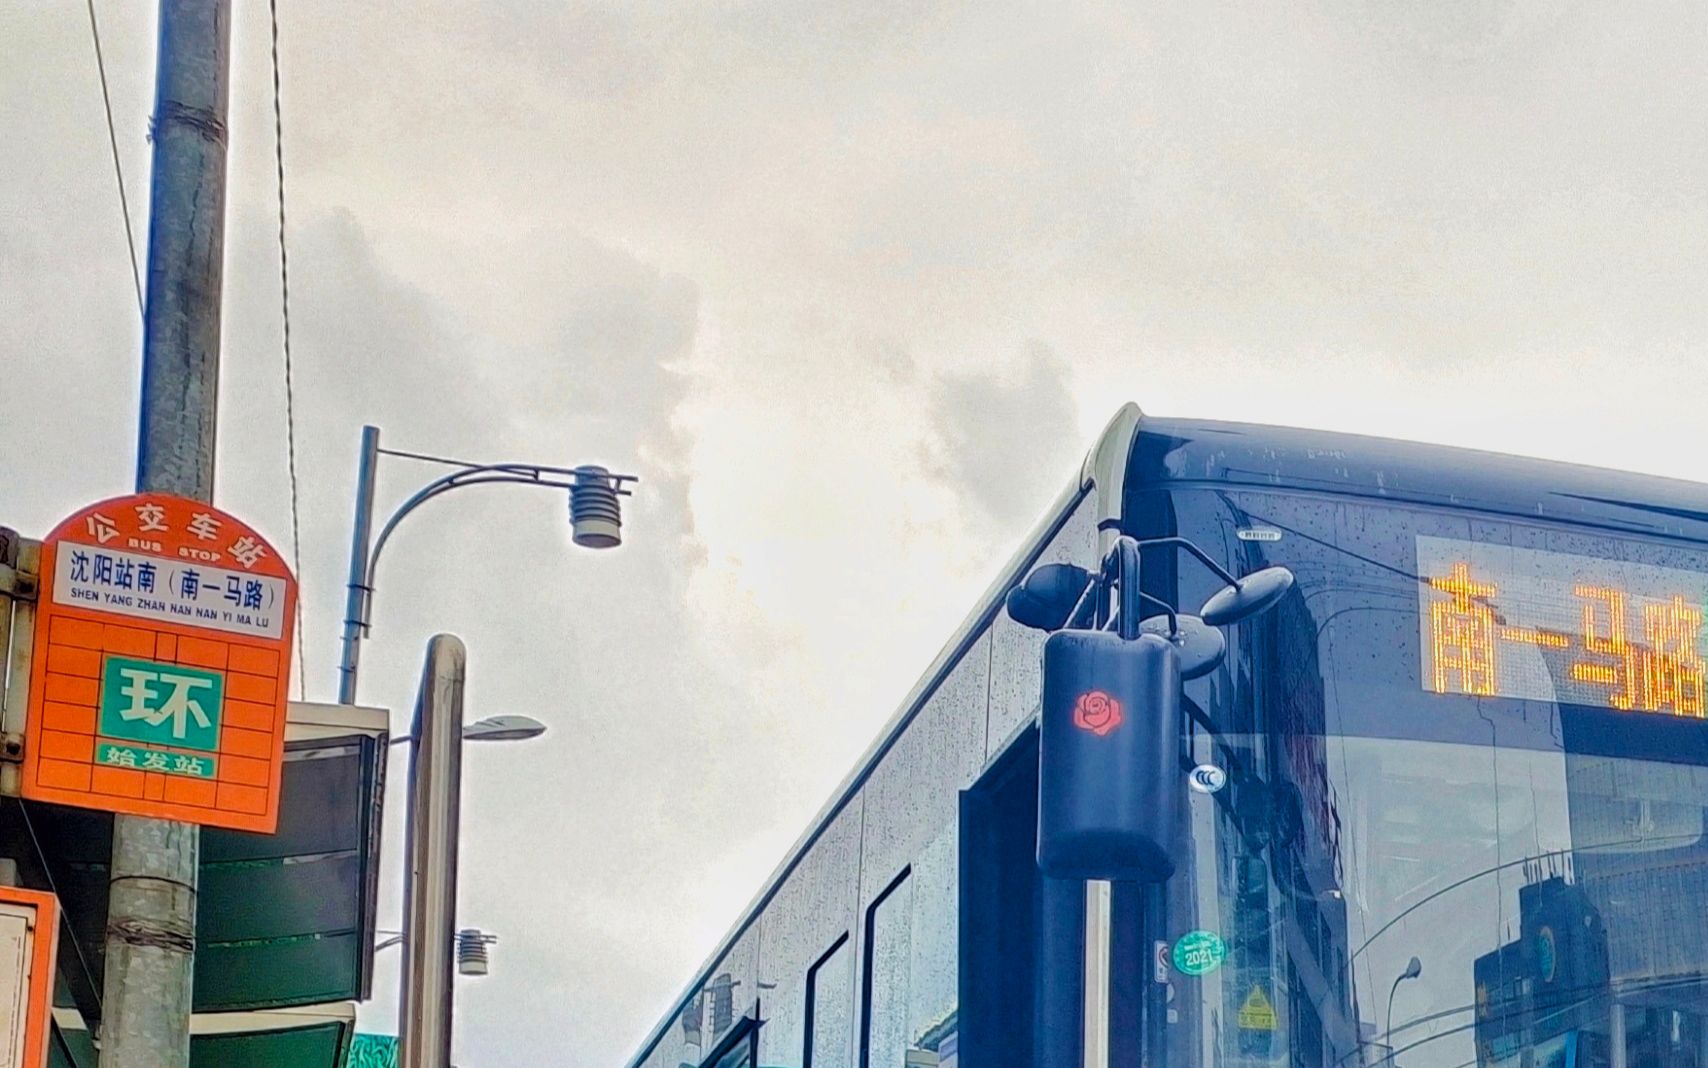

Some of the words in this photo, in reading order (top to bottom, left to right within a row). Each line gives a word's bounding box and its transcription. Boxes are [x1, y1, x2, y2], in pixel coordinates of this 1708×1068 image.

[85, 501, 268, 569] 公交车站
[128, 538, 163, 553] BUS
[178, 546, 222, 563] STOP
[70, 587, 100, 600] SHEN
[104, 592, 133, 607] YANG
[137, 597, 166, 613] ZHAN
[170, 603, 192, 617] NAN
[195, 607, 218, 621] NAN
[222, 611, 233, 623] YI
[236, 613, 252, 626] MA
[255, 616, 270, 628] LU
[1430, 562, 1707, 719] 南一马路
[119, 667, 213, 739] 环
[106, 746, 205, 776] 始发站
[1185, 949, 1214, 967] 2021
